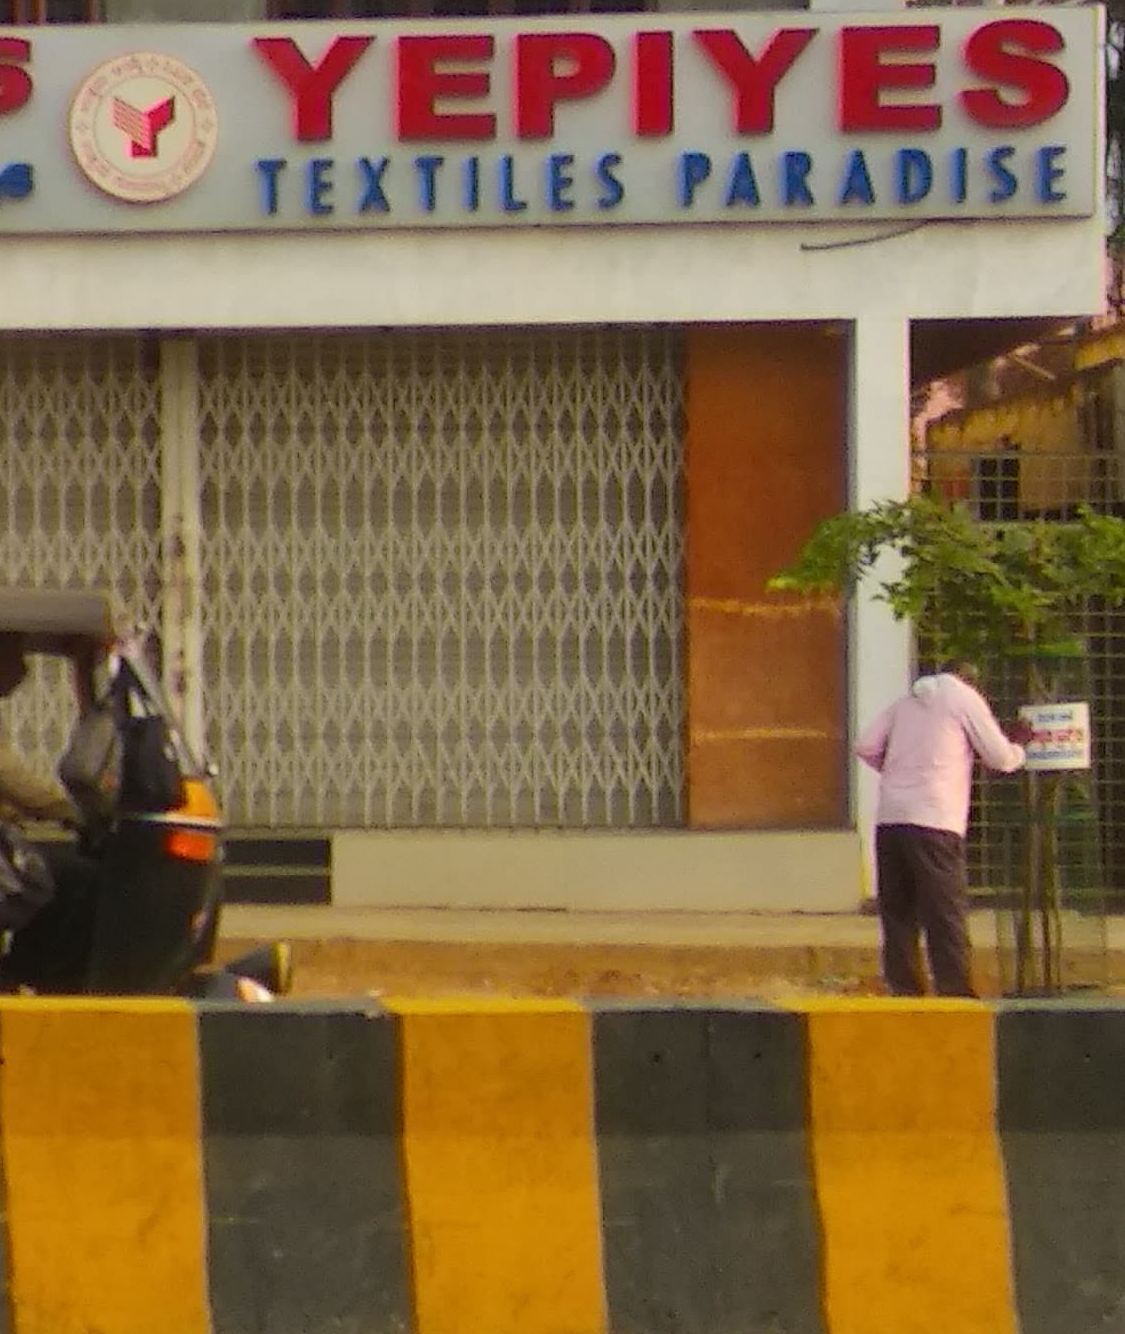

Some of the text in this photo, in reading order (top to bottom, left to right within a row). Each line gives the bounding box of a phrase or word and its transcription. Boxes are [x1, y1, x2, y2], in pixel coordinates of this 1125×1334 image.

[253, 19, 1070, 143] YEPIYES
[256, 146, 1069, 216] TEXTILES PARADISE
